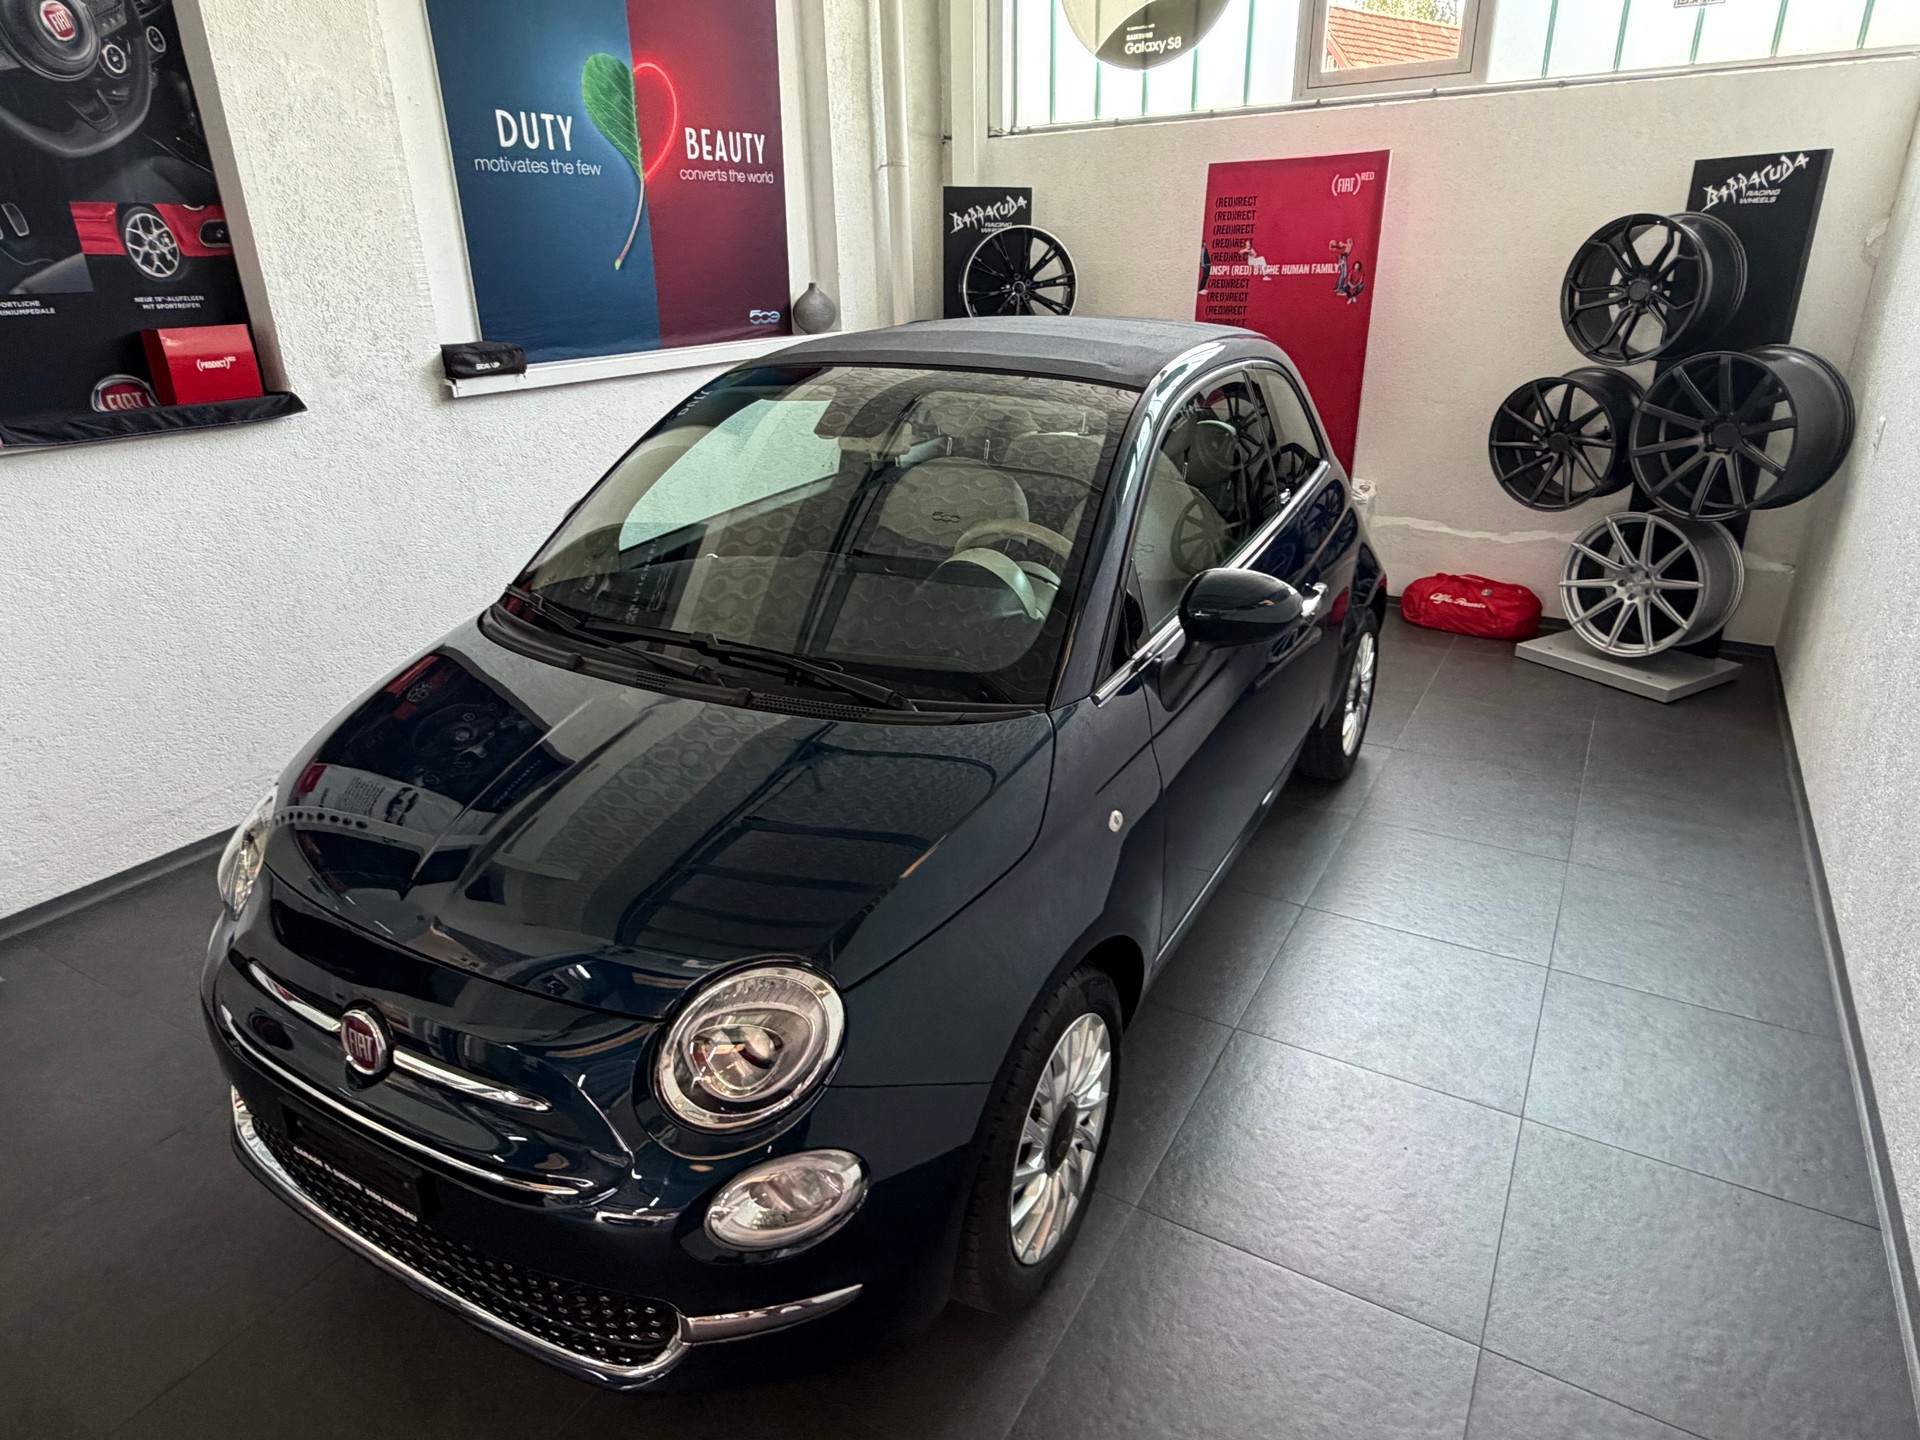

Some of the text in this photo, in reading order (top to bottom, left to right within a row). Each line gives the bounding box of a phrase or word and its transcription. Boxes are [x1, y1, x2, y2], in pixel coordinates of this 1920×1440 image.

[1124, 36, 1182, 55] Galaxy S8
[495, 109, 573, 151] DUTY
[685, 127, 765, 164] BEAUTY
[474, 157, 602, 176] motivates the few
[680, 168, 774, 184] converts the world
[1702, 152, 1810, 212] BARRACUDA
[1746, 189, 1782, 197] RACING
[949, 195, 1028, 234] BARRACUDA
[1281, 264, 1310, 275] HUMAN
[348, 1027, 374, 1062] FIAT
